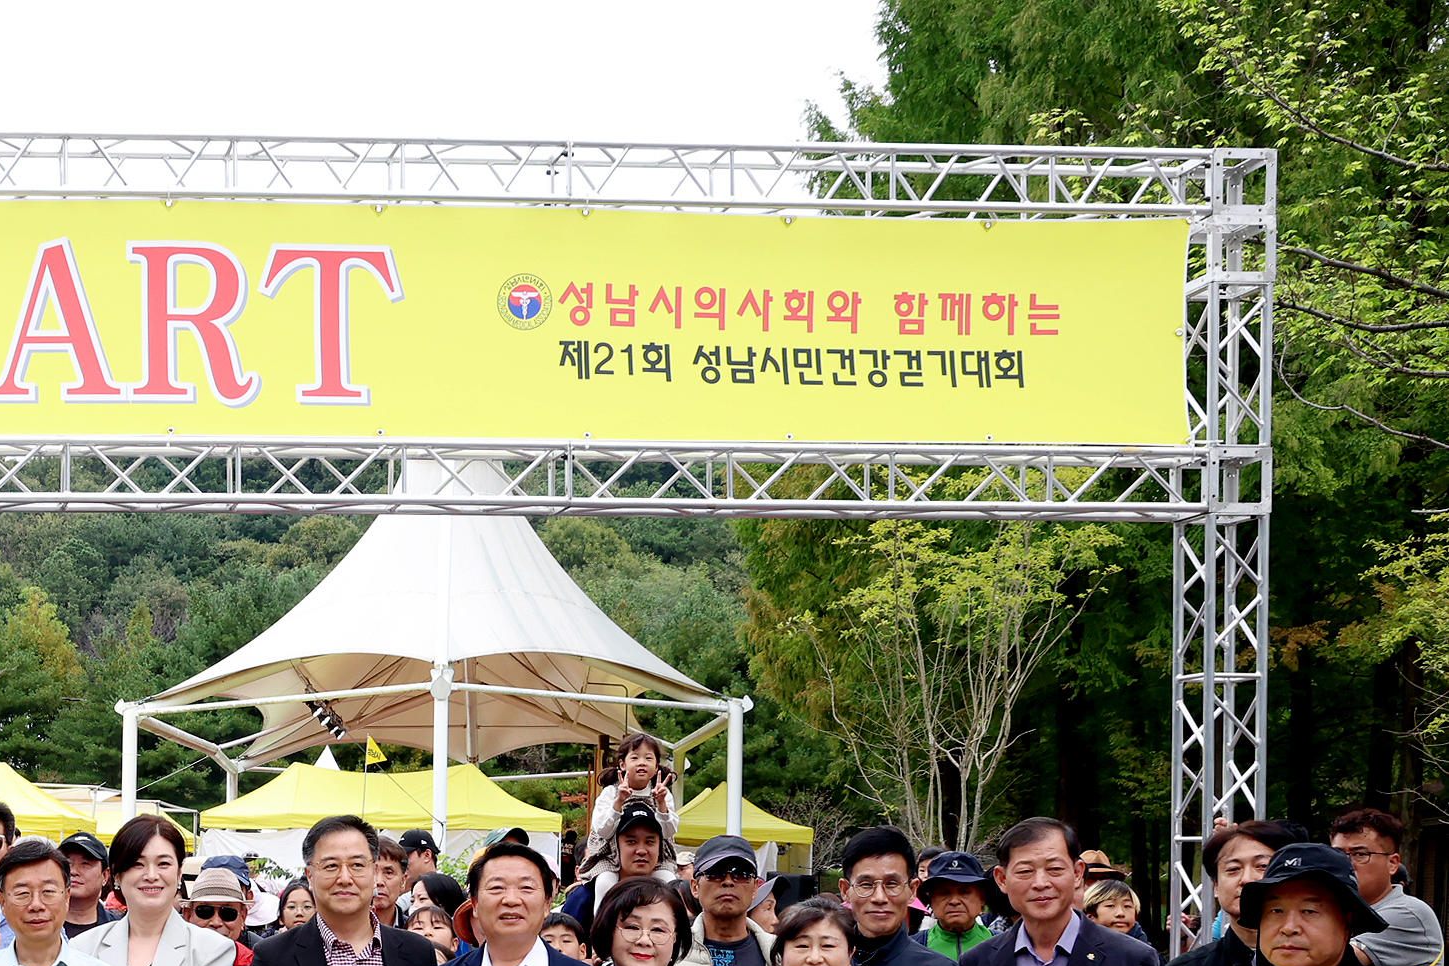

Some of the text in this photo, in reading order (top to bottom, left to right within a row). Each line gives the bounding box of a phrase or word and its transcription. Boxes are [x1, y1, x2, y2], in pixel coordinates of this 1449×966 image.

[559, 281, 1061, 336] 성남시의사회와 함께하는
[559, 340, 1025, 389] 제21회 성남시민건강걷기대회
